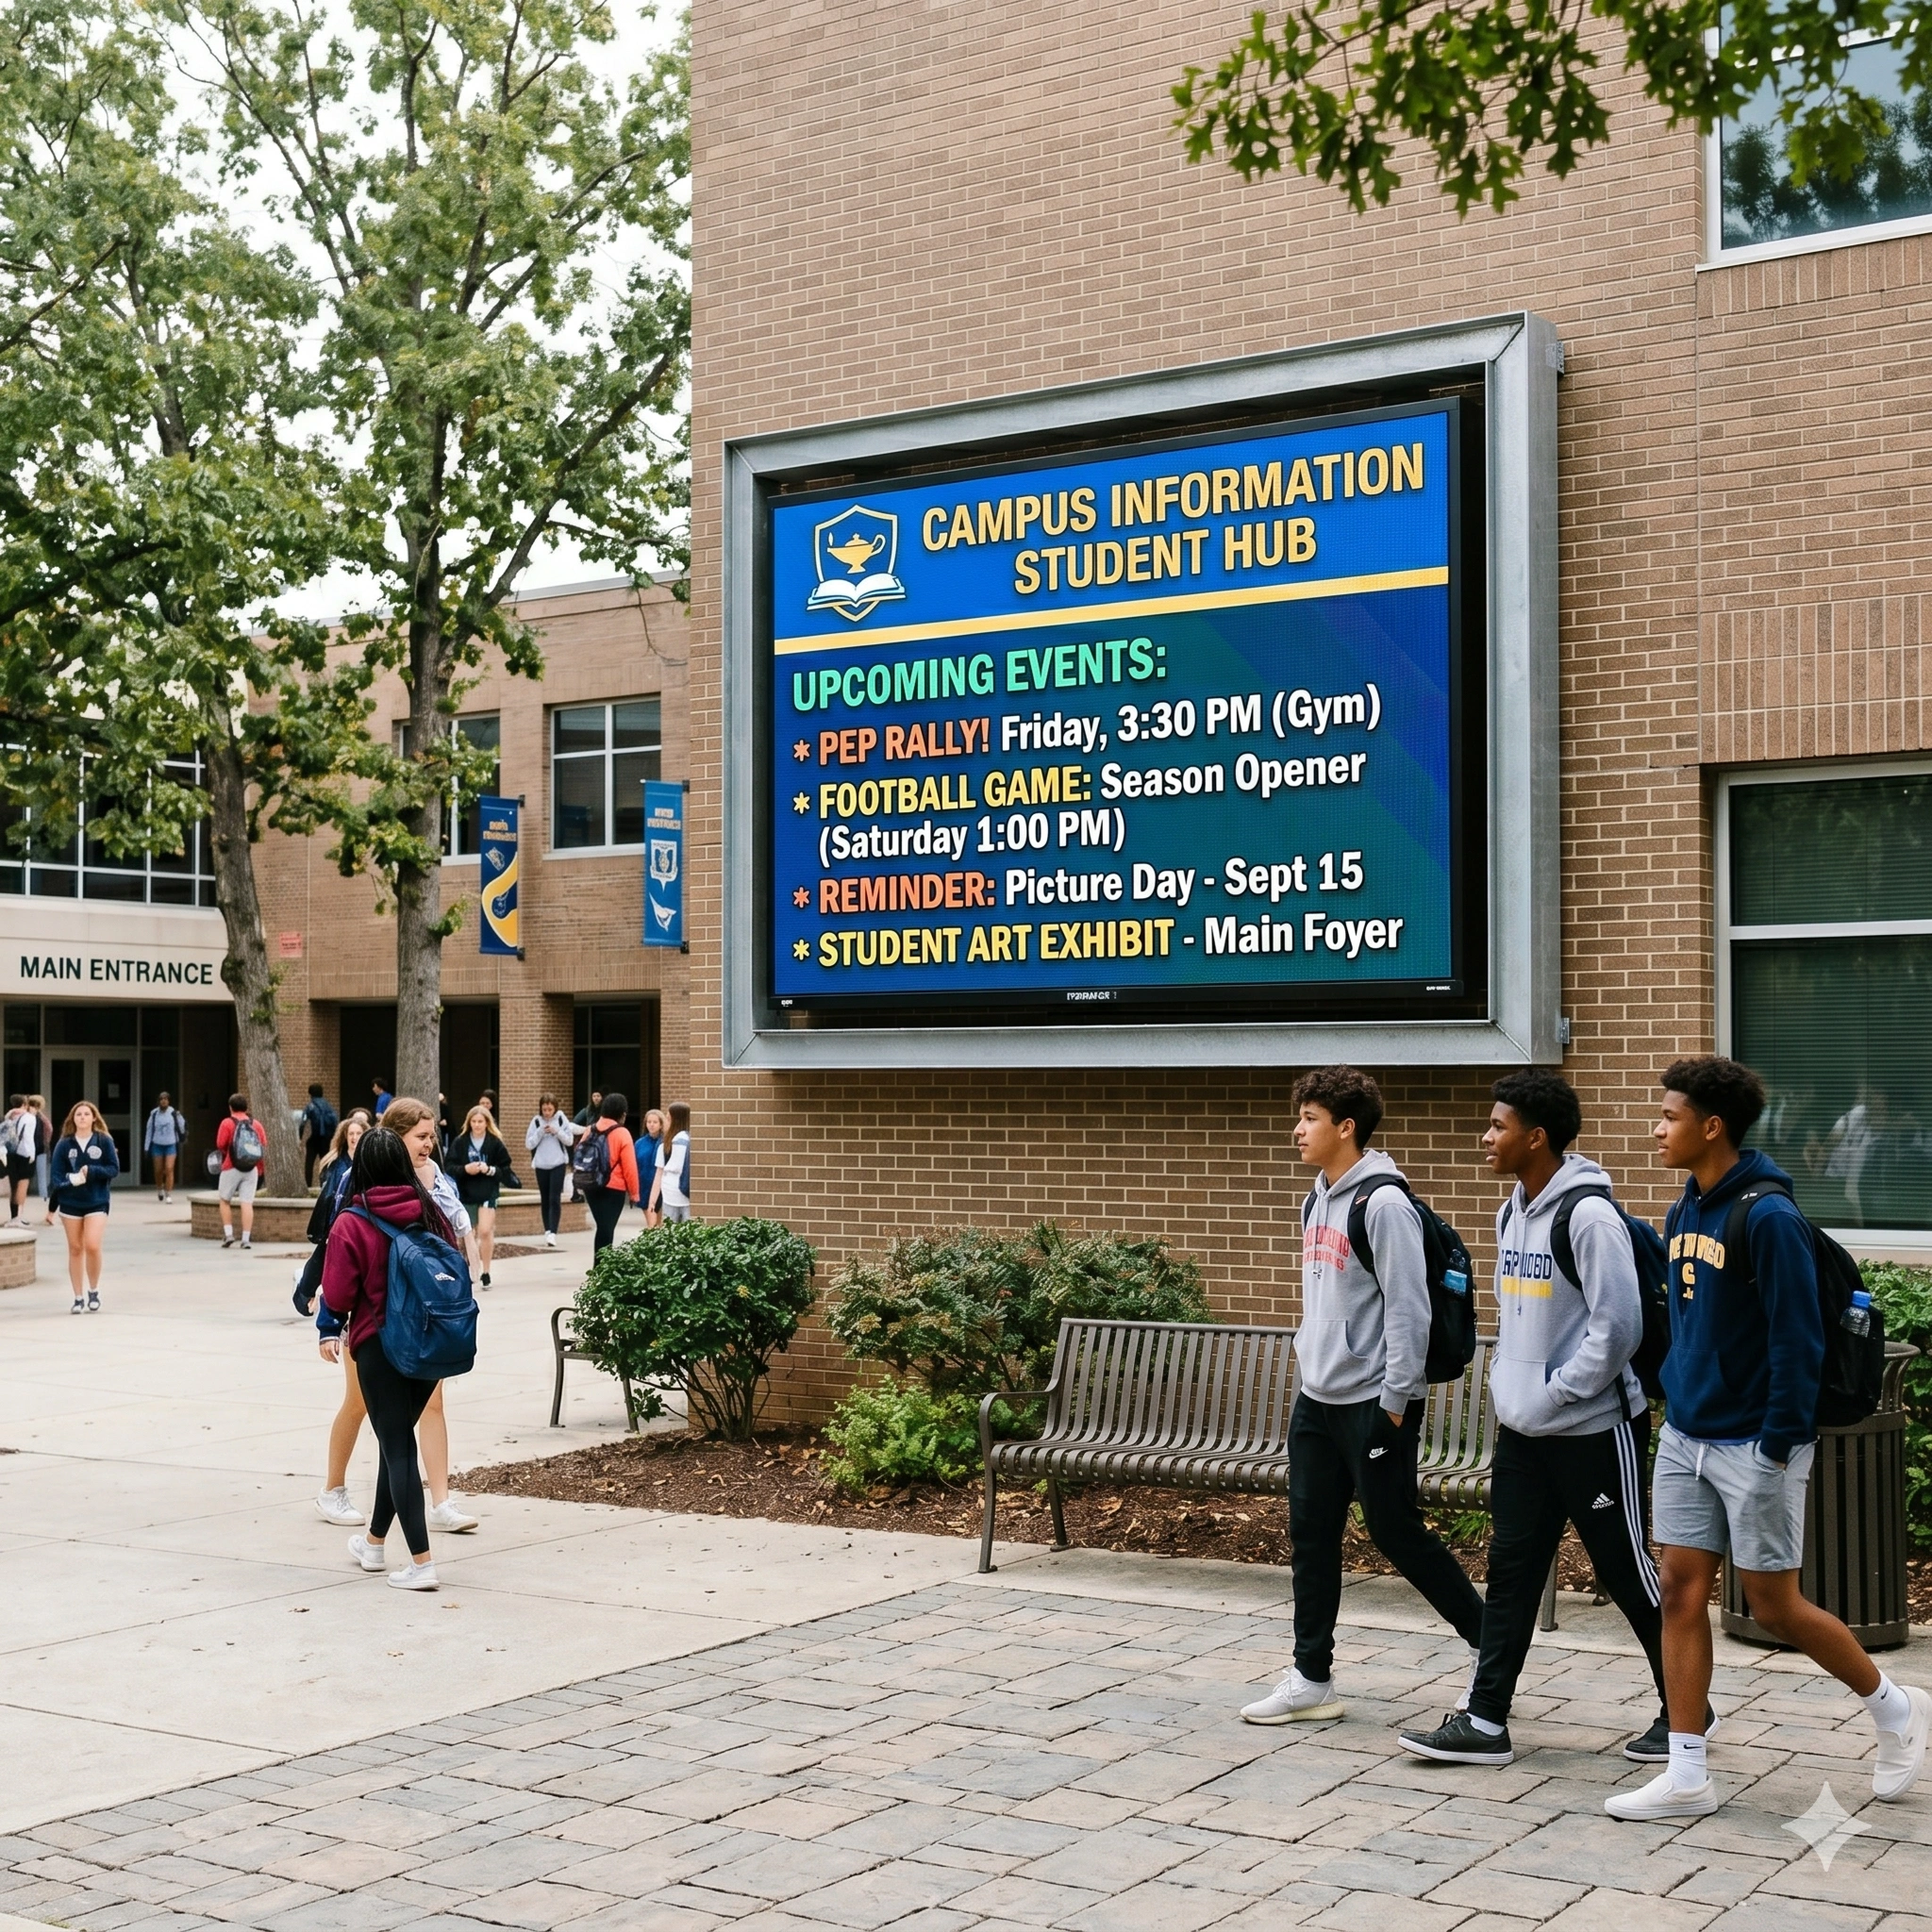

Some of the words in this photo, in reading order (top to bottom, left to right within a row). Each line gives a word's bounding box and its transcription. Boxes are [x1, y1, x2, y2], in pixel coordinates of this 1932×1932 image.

[923, 488, 1096, 552] CAMPUS
[1111, 442, 1424, 527] INFORMATION
[1015, 529, 1210, 594] STUDENT
[1224, 517, 1317, 571] HUB
[793, 653, 994, 711] UPCOMING
[1007, 637, 1166, 691] EVENTS:
[820, 727, 877, 765] PEP
[885, 718, 990, 760] RALLY!
[1002, 711, 1108, 754] Friday,
[1117, 700, 1196, 741] 3:30
[1207, 693, 1261, 735] PM
[1272, 683, 1381, 739] (Gym)
[820, 774, 976, 819] FOOTBALL
[984, 765, 1091, 808] GAME:
[1100, 762, 1224, 799] Season
[1235, 753, 1366, 798] Opener
[819, 820, 968, 868] (Saturday
[977, 812, 1049, 852] 1:00
[1058, 808, 1125, 852] PM)
[820, 872, 995, 913] REMINDER:
[1006, 868, 1123, 906] Picture
[1133, 863, 1195, 907] Day
[1224, 856, 1307, 903] Sept
[1319, 851, 1363, 891] 15
[21, 956, 81, 980] MAIN
[90, 958, 213, 985] ENTRANCE
[819, 927, 962, 967] STUDENT
[967, 924, 1032, 962] ART
[1041, 919, 1174, 959] EXHIBIT
[1205, 914, 1293, 955] Main
[1305, 912, 1404, 959] Foyer
